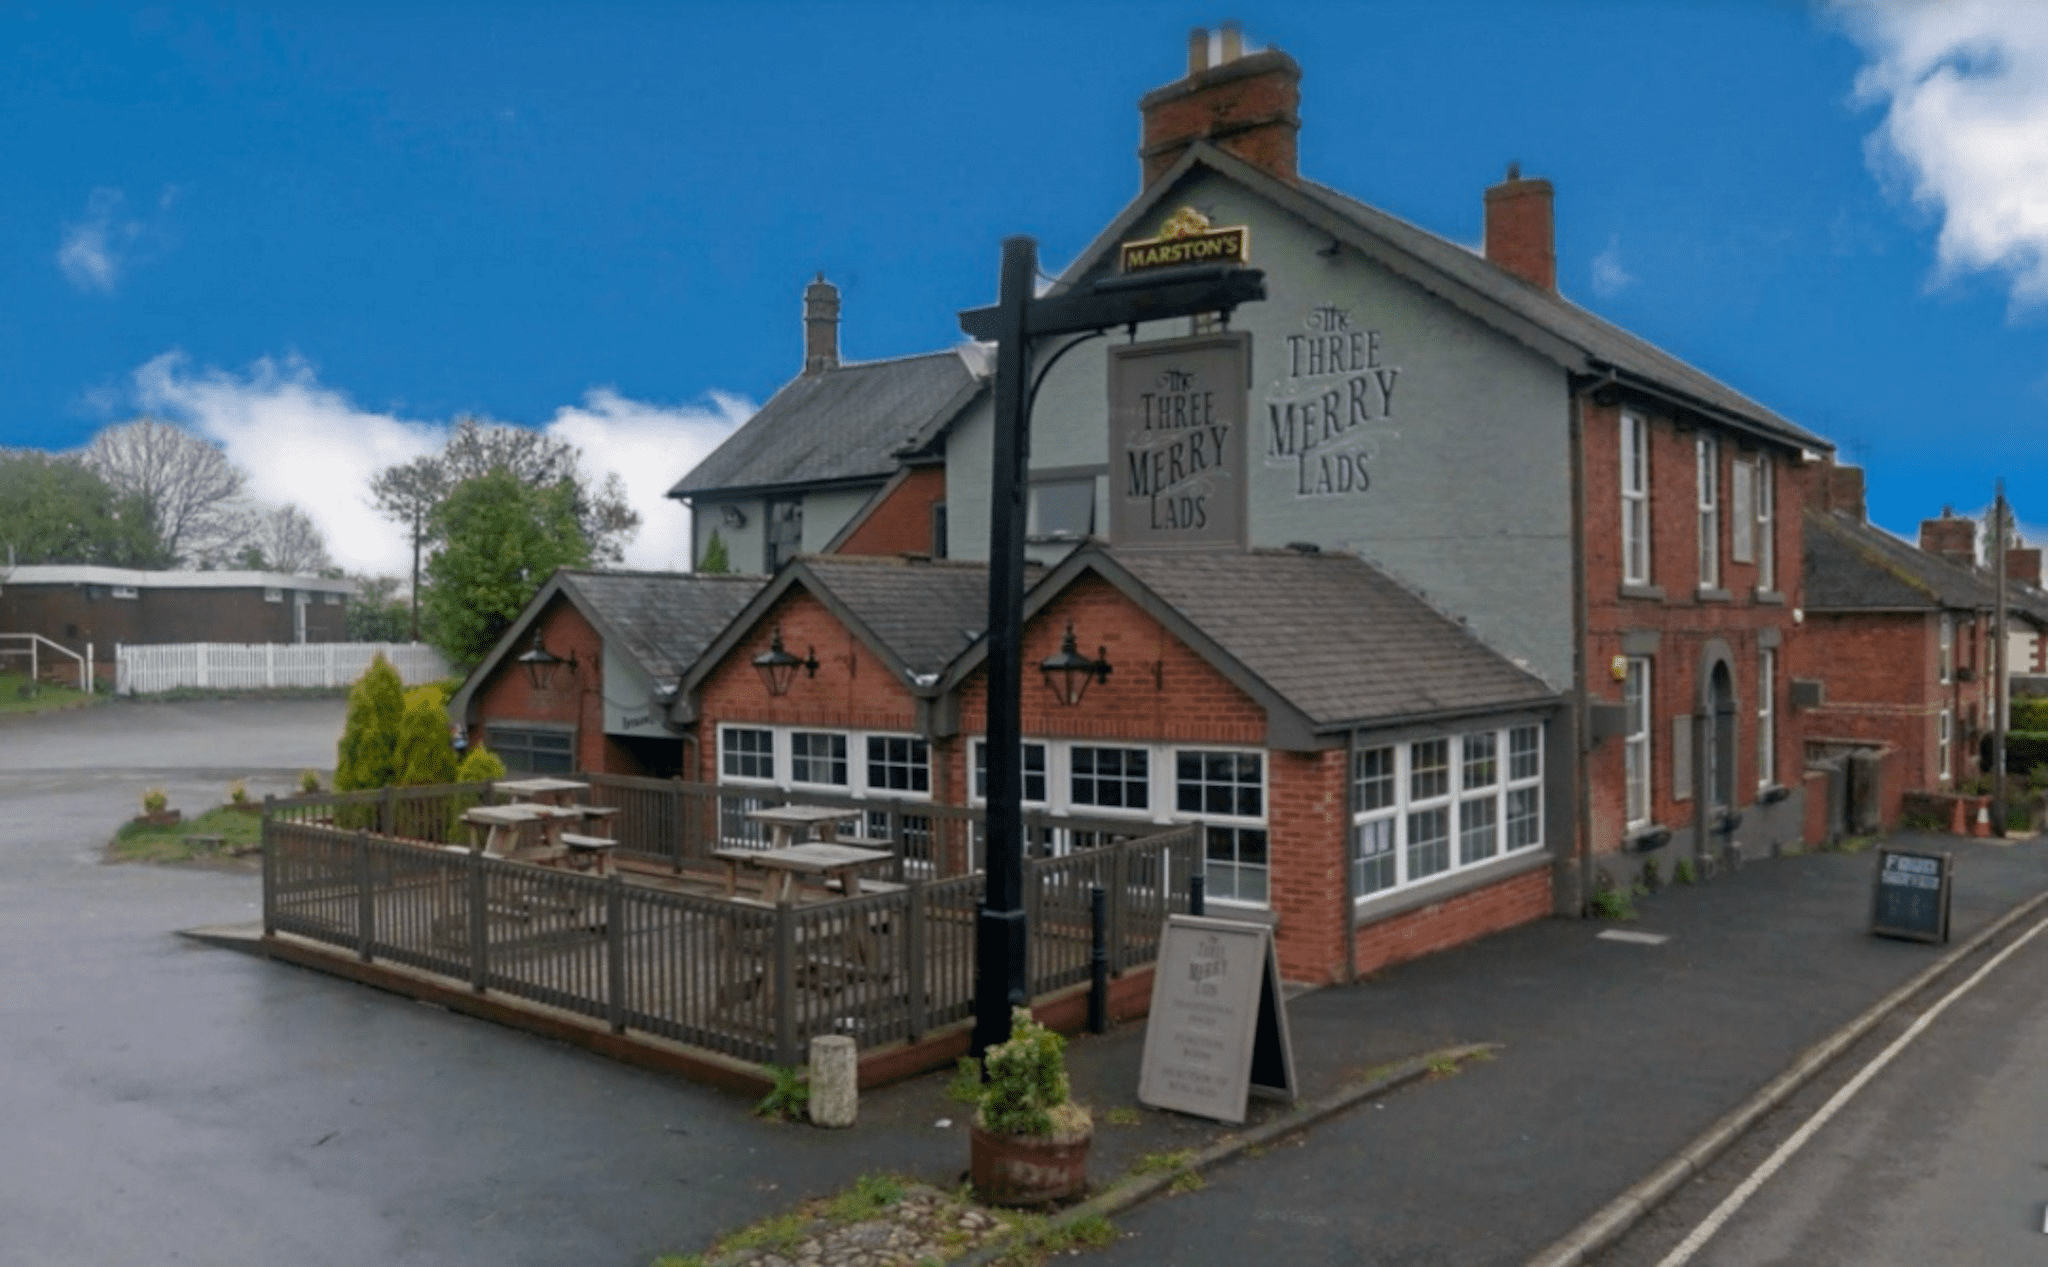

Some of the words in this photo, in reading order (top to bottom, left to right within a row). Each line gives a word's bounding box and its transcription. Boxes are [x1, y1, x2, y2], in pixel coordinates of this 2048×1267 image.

[1128, 235, 1238, 267] MARSTON'S
[1287, 330, 1381, 378] THREE
[1141, 392, 1214, 430] THREE
[1268, 370, 1398, 456] MERRY
[1126, 426, 1228, 497] MERRY
[1297, 452, 1370, 495] LADS
[1150, 495, 1206, 530] LADS
